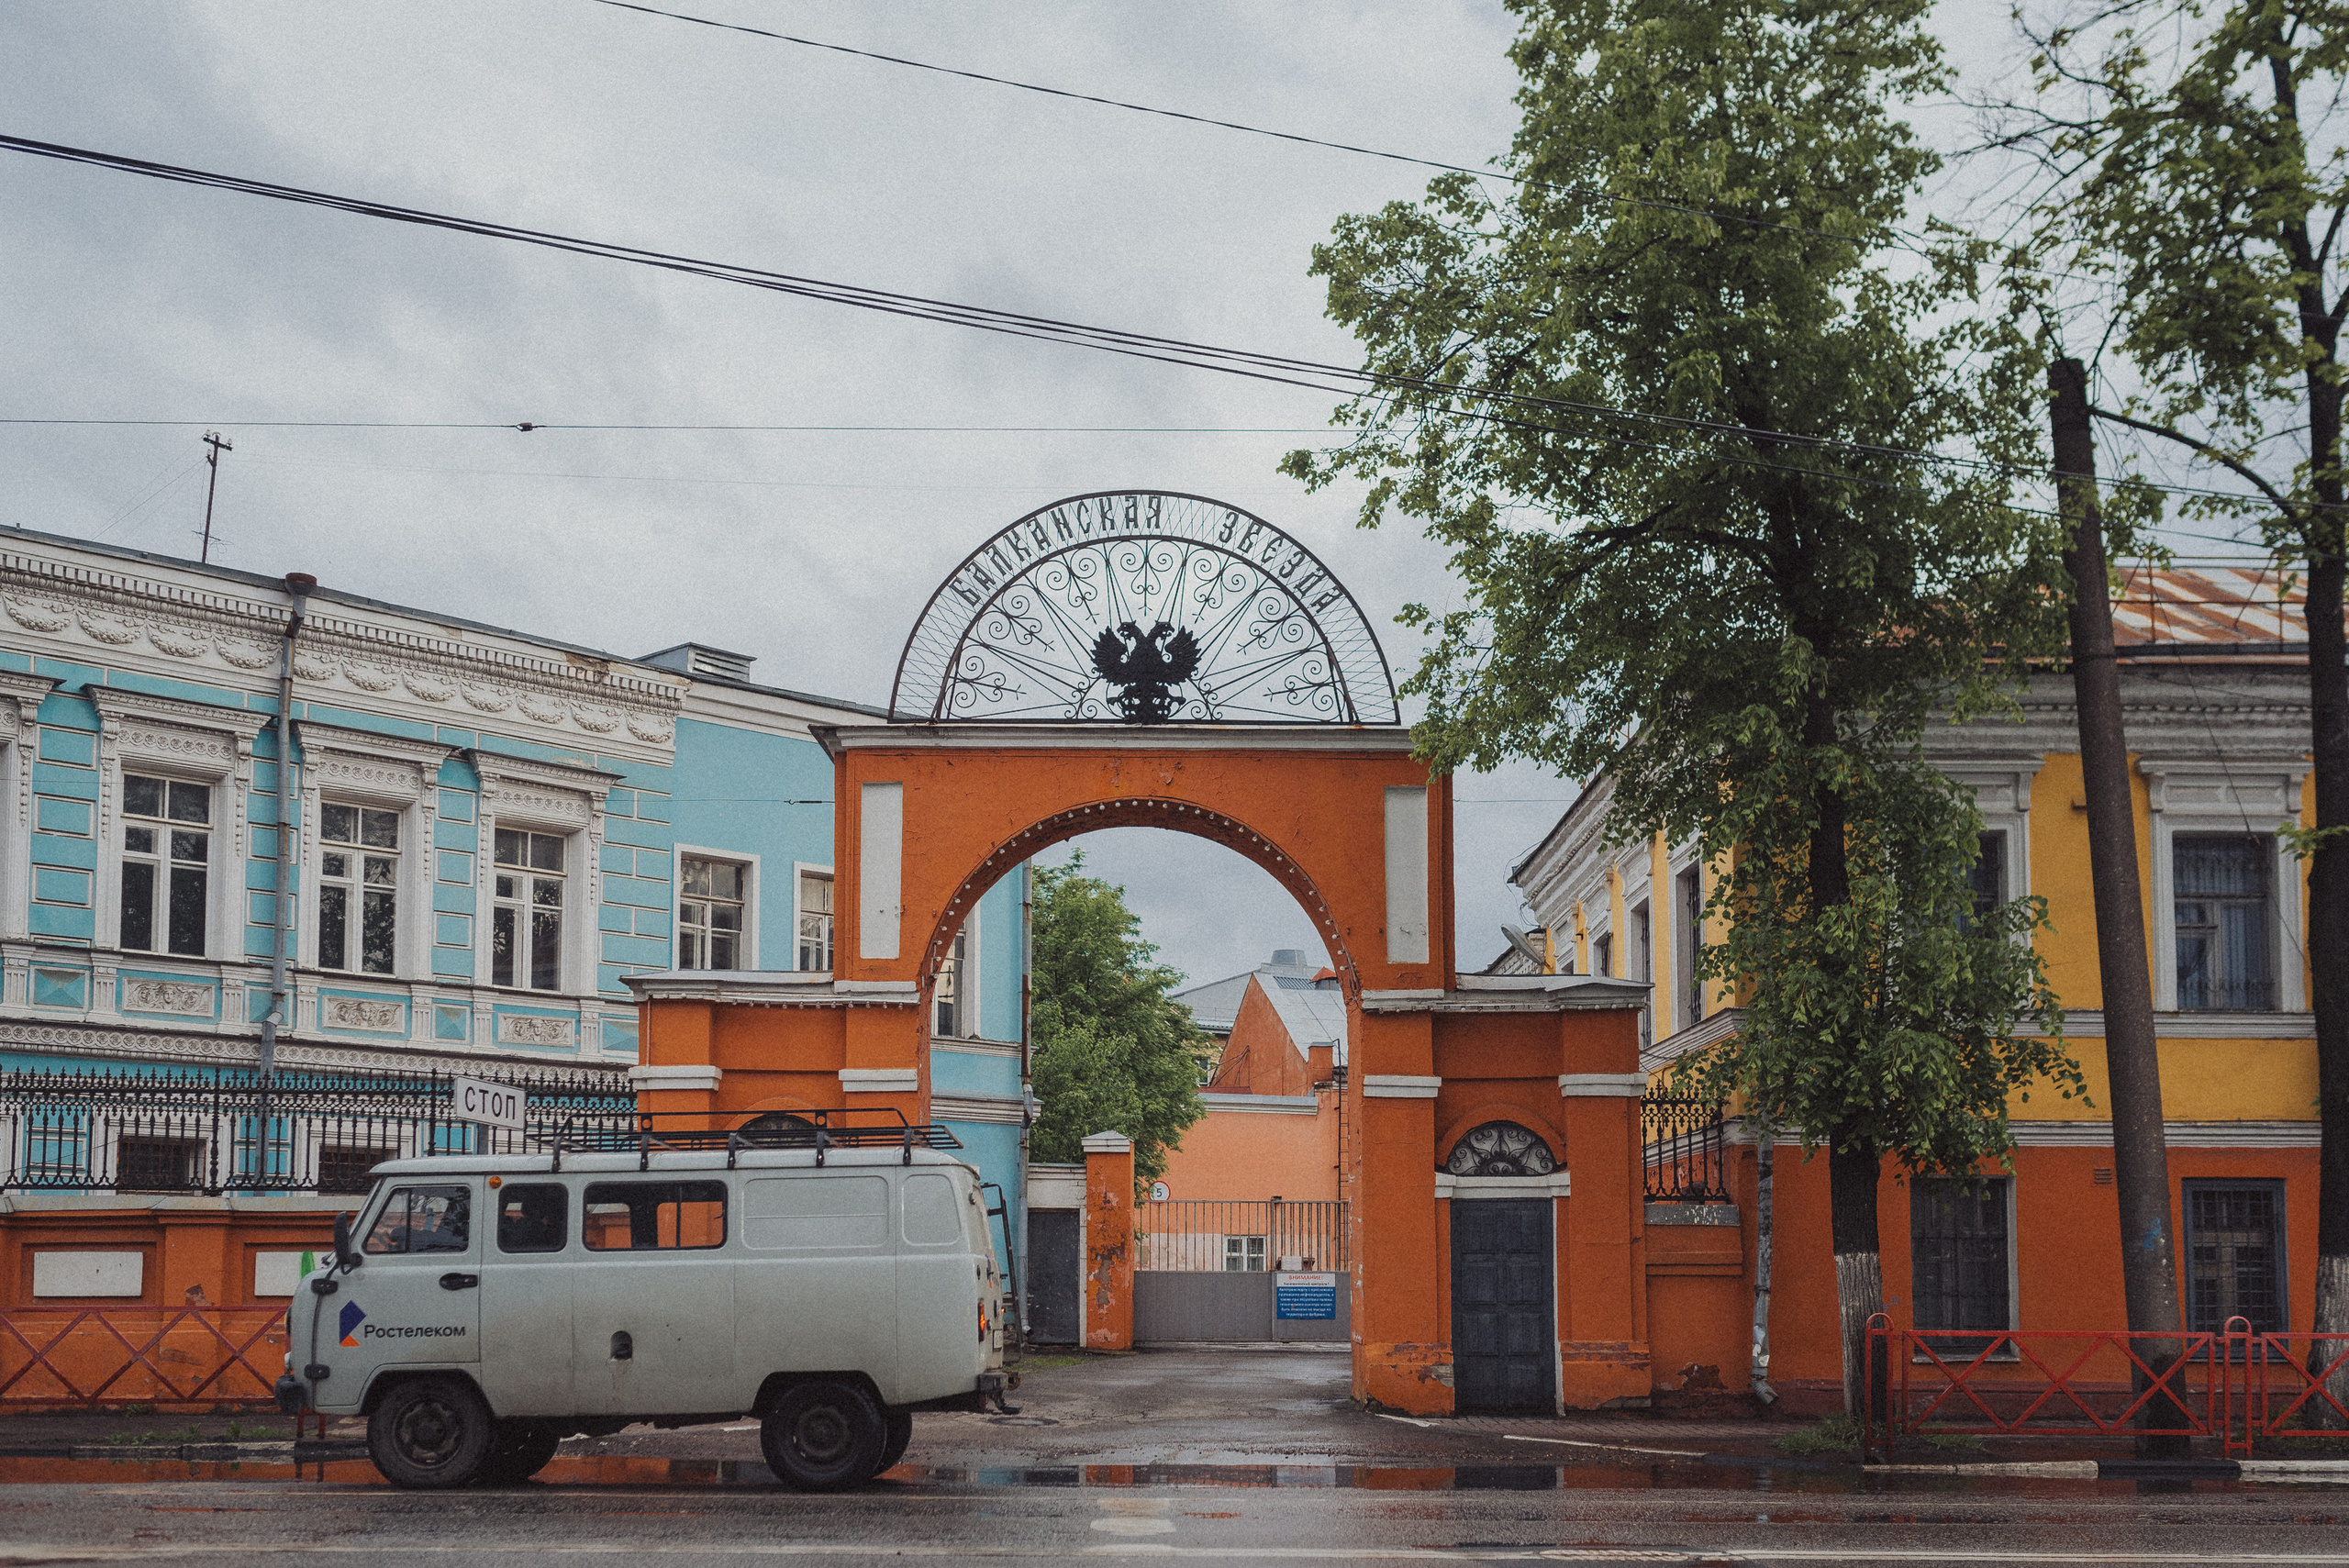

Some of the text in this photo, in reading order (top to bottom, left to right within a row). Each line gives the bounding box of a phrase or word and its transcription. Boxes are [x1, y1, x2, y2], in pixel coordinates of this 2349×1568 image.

[948, 495, 1343, 614] БАЛКАНСКАЯ ЗВЕЗДА
[464, 1085, 516, 1120] СТОП
[1156, 1187, 1163, 1197] 5
[363, 1324, 466, 1339] Ростелеком
